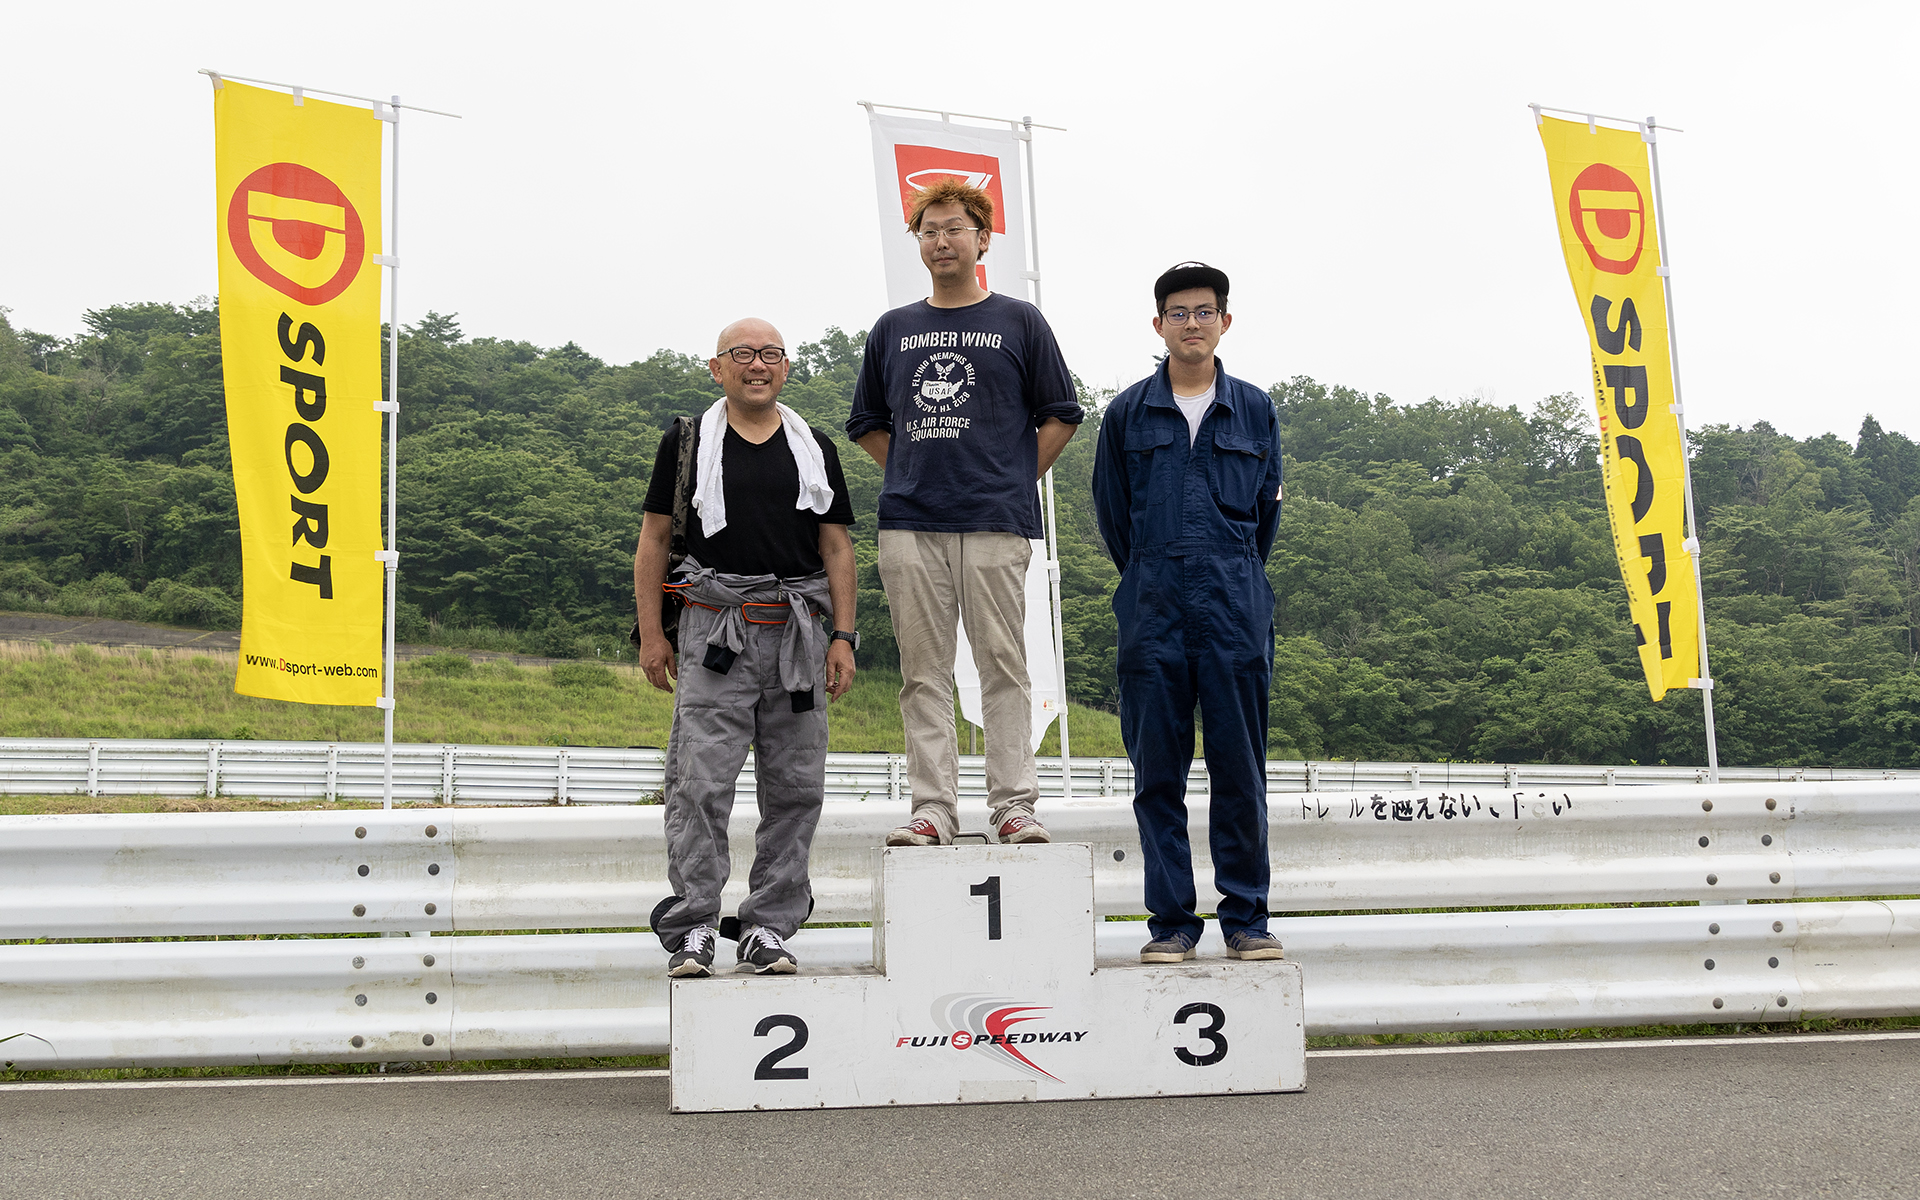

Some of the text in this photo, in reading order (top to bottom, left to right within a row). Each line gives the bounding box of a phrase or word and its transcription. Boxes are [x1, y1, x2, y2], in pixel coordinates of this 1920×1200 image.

[900, 331, 1002, 352] BOMBER WING
[929, 351, 967, 365] MEMPHIS
[964, 362, 976, 386] BELLE
[928, 387, 952, 395] USAF
[952, 391, 970, 408] 8212
[940, 404, 951, 412] TH
[906, 416, 970, 432] U.S. AIR FORCE
[911, 427, 960, 441] SQUADRON
[276, 311, 333, 599] SPORT
[245, 654, 378, 679] www.Dsport-web.com
[970, 876, 1003, 940] 1
[896, 1031, 1089, 1050] FUJI SPEEDWAY
[1173, 1002, 1229, 1066] 3
[754, 1014, 809, 1080] 2
